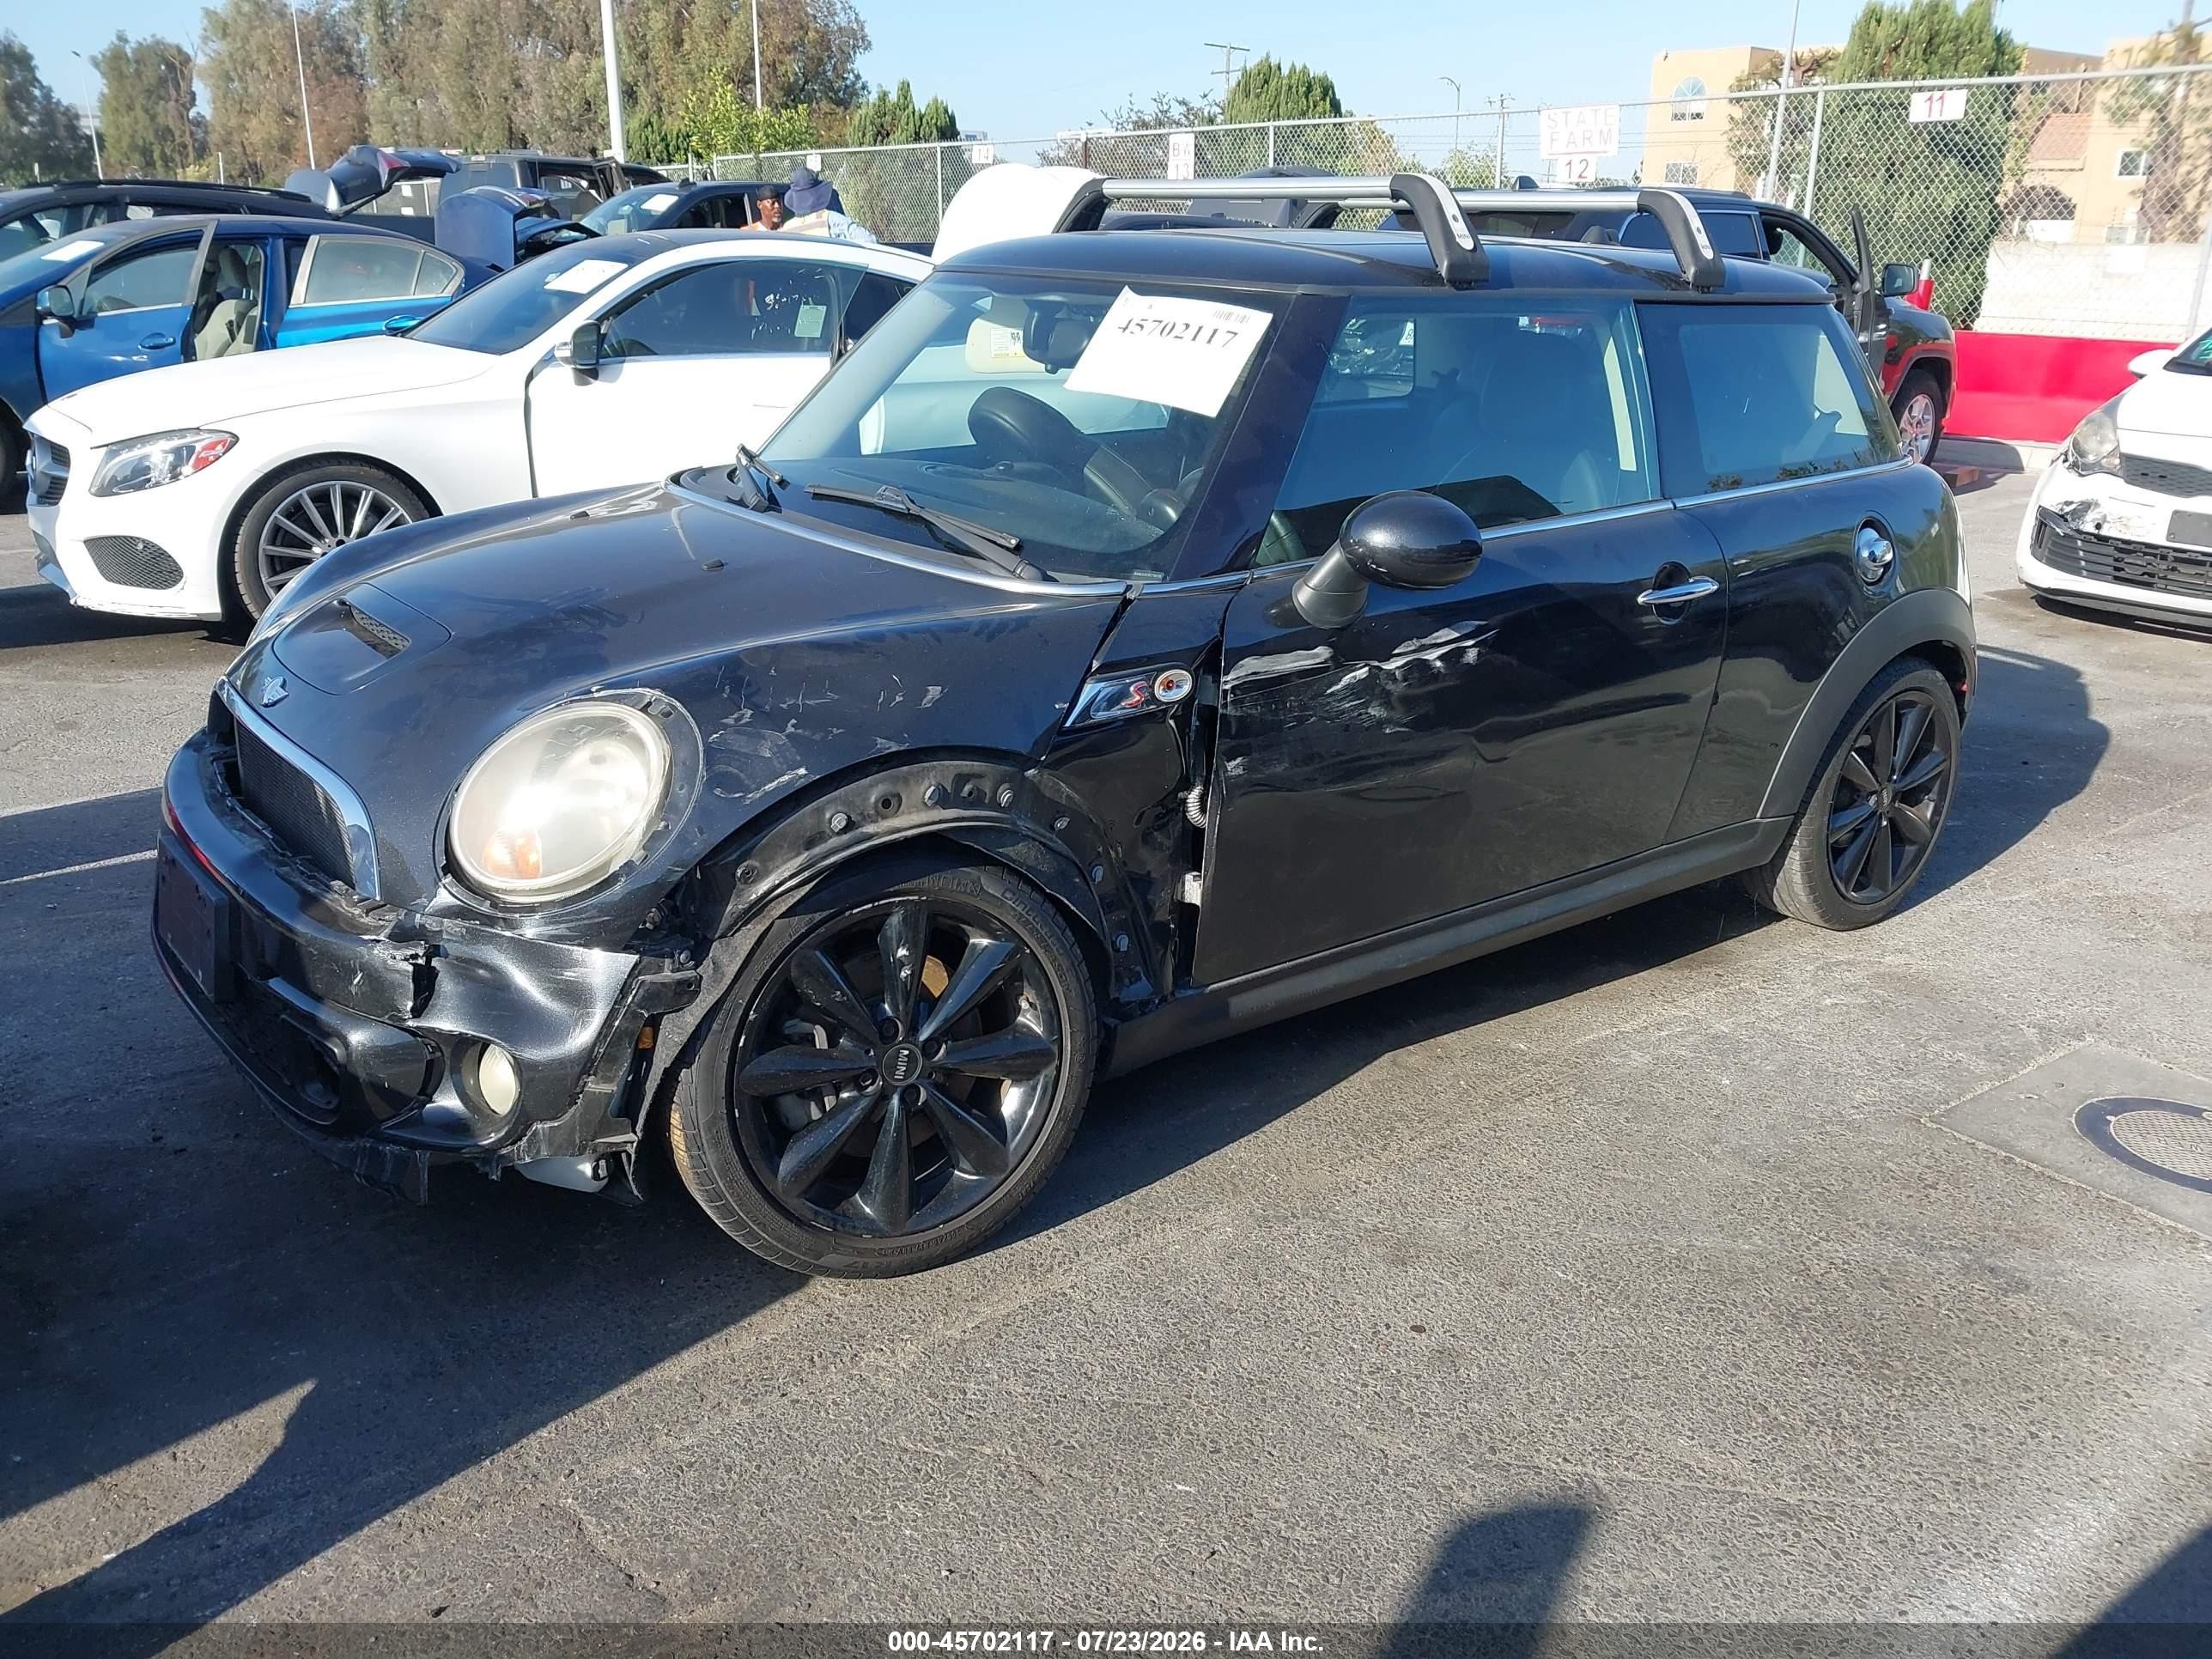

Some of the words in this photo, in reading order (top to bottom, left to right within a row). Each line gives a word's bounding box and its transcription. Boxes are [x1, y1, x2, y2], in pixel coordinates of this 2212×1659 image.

[1924, 92, 1945, 118] 11
[1547, 107, 1615, 130] STATE
[1549, 129, 1613, 151] FARM
[1565, 158, 1589, 179] 12
[1118, 317, 1239, 348] 45702117
[894, 1049, 910, 1079] MINI
